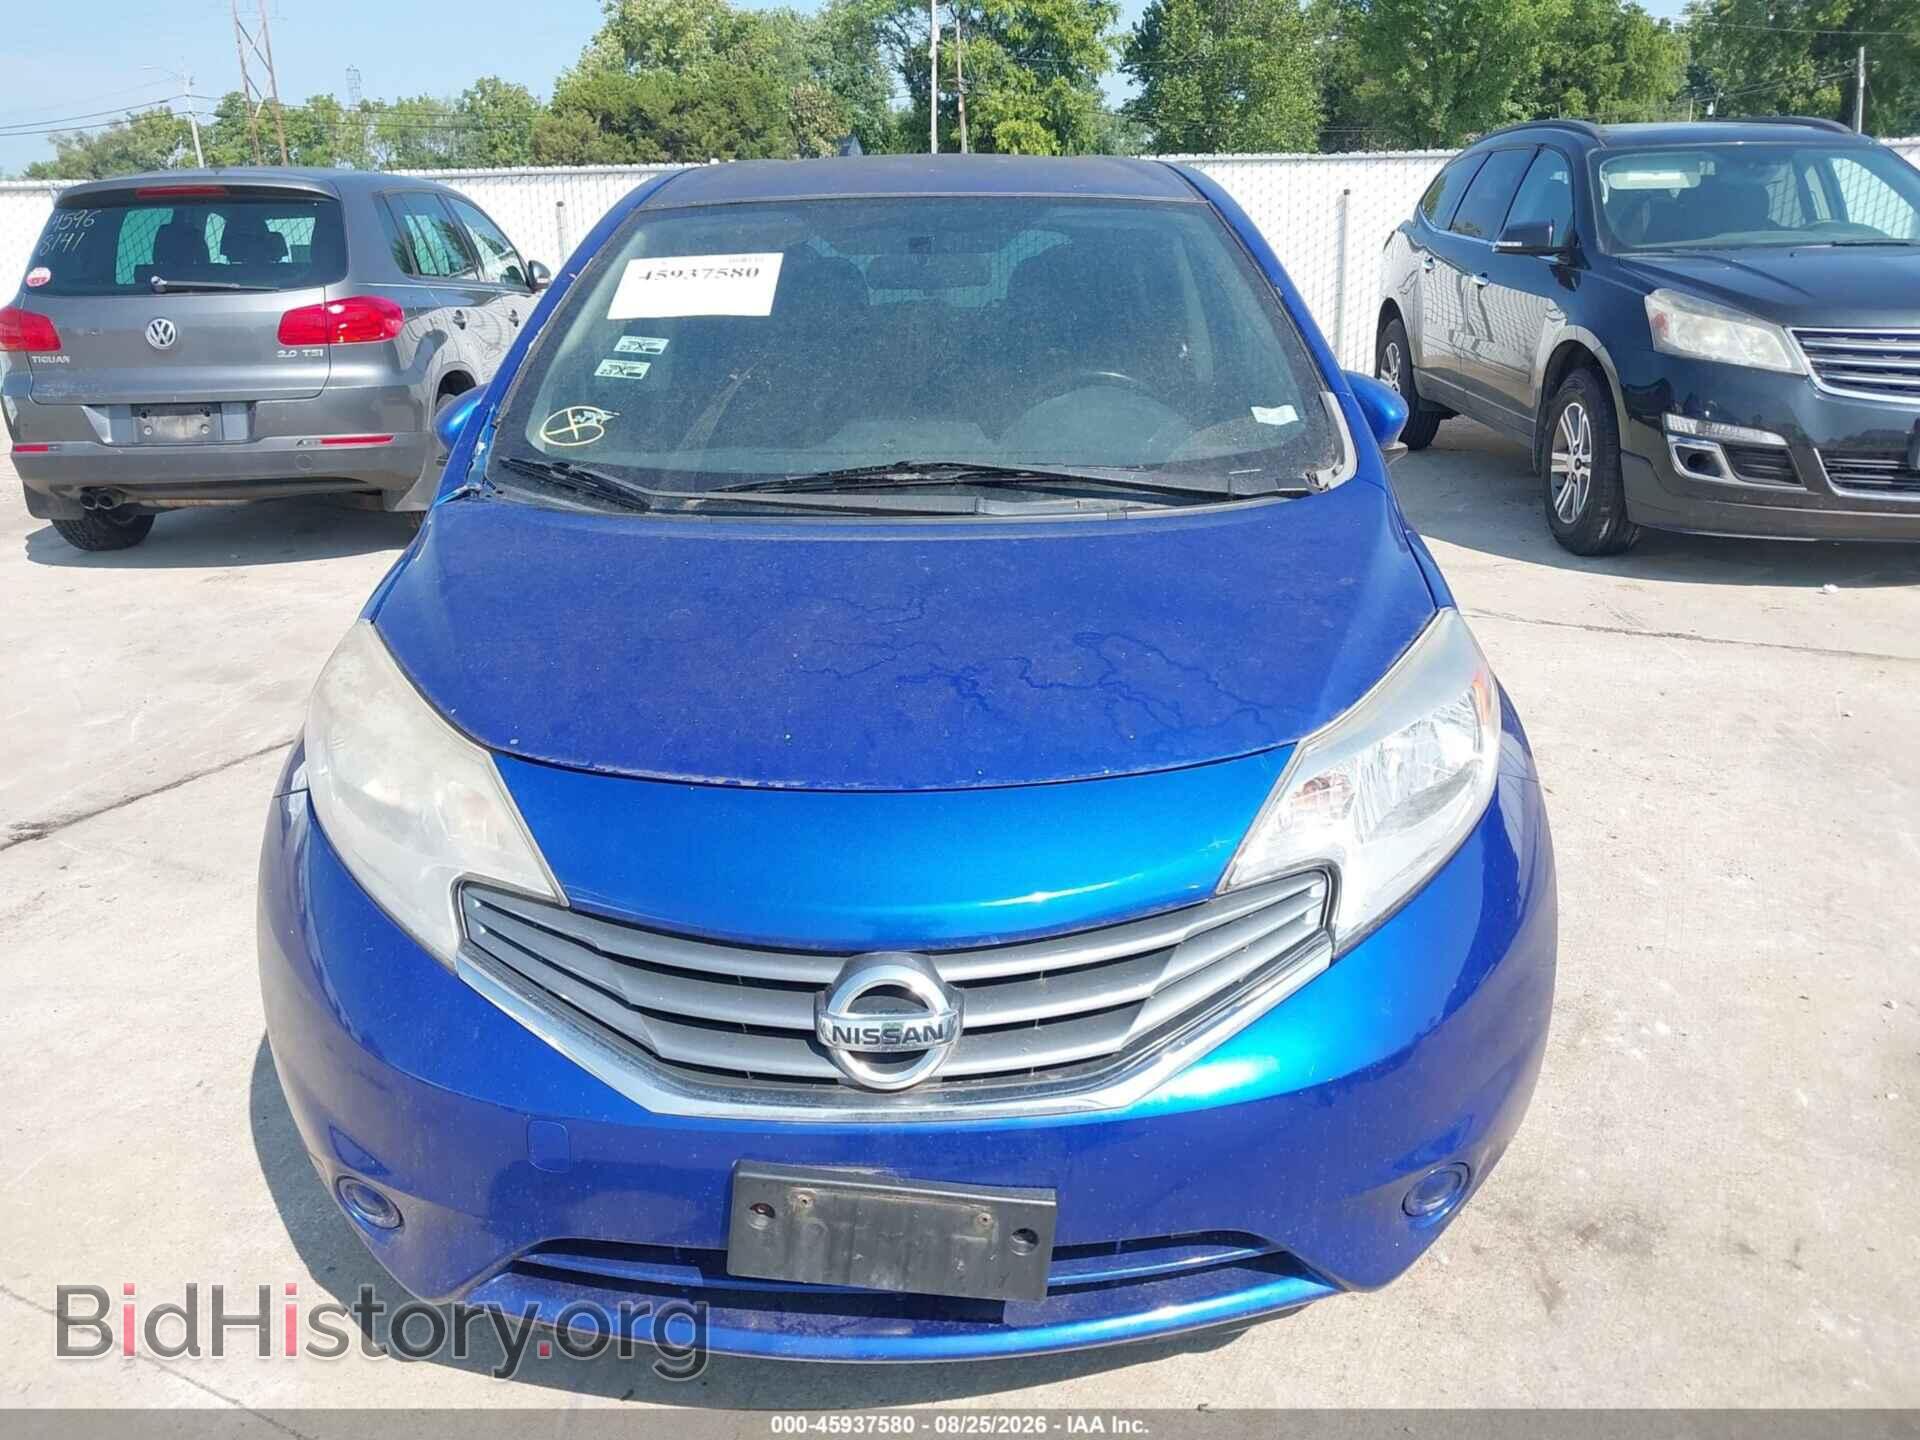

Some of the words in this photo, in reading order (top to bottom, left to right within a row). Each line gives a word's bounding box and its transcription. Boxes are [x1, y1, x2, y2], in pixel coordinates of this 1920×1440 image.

[638, 267, 760, 281] 45937580
[301, 349, 324, 357] TSI
[31, 355, 70, 364] TIGUAN
[832, 1023, 944, 1046] NISSAN
